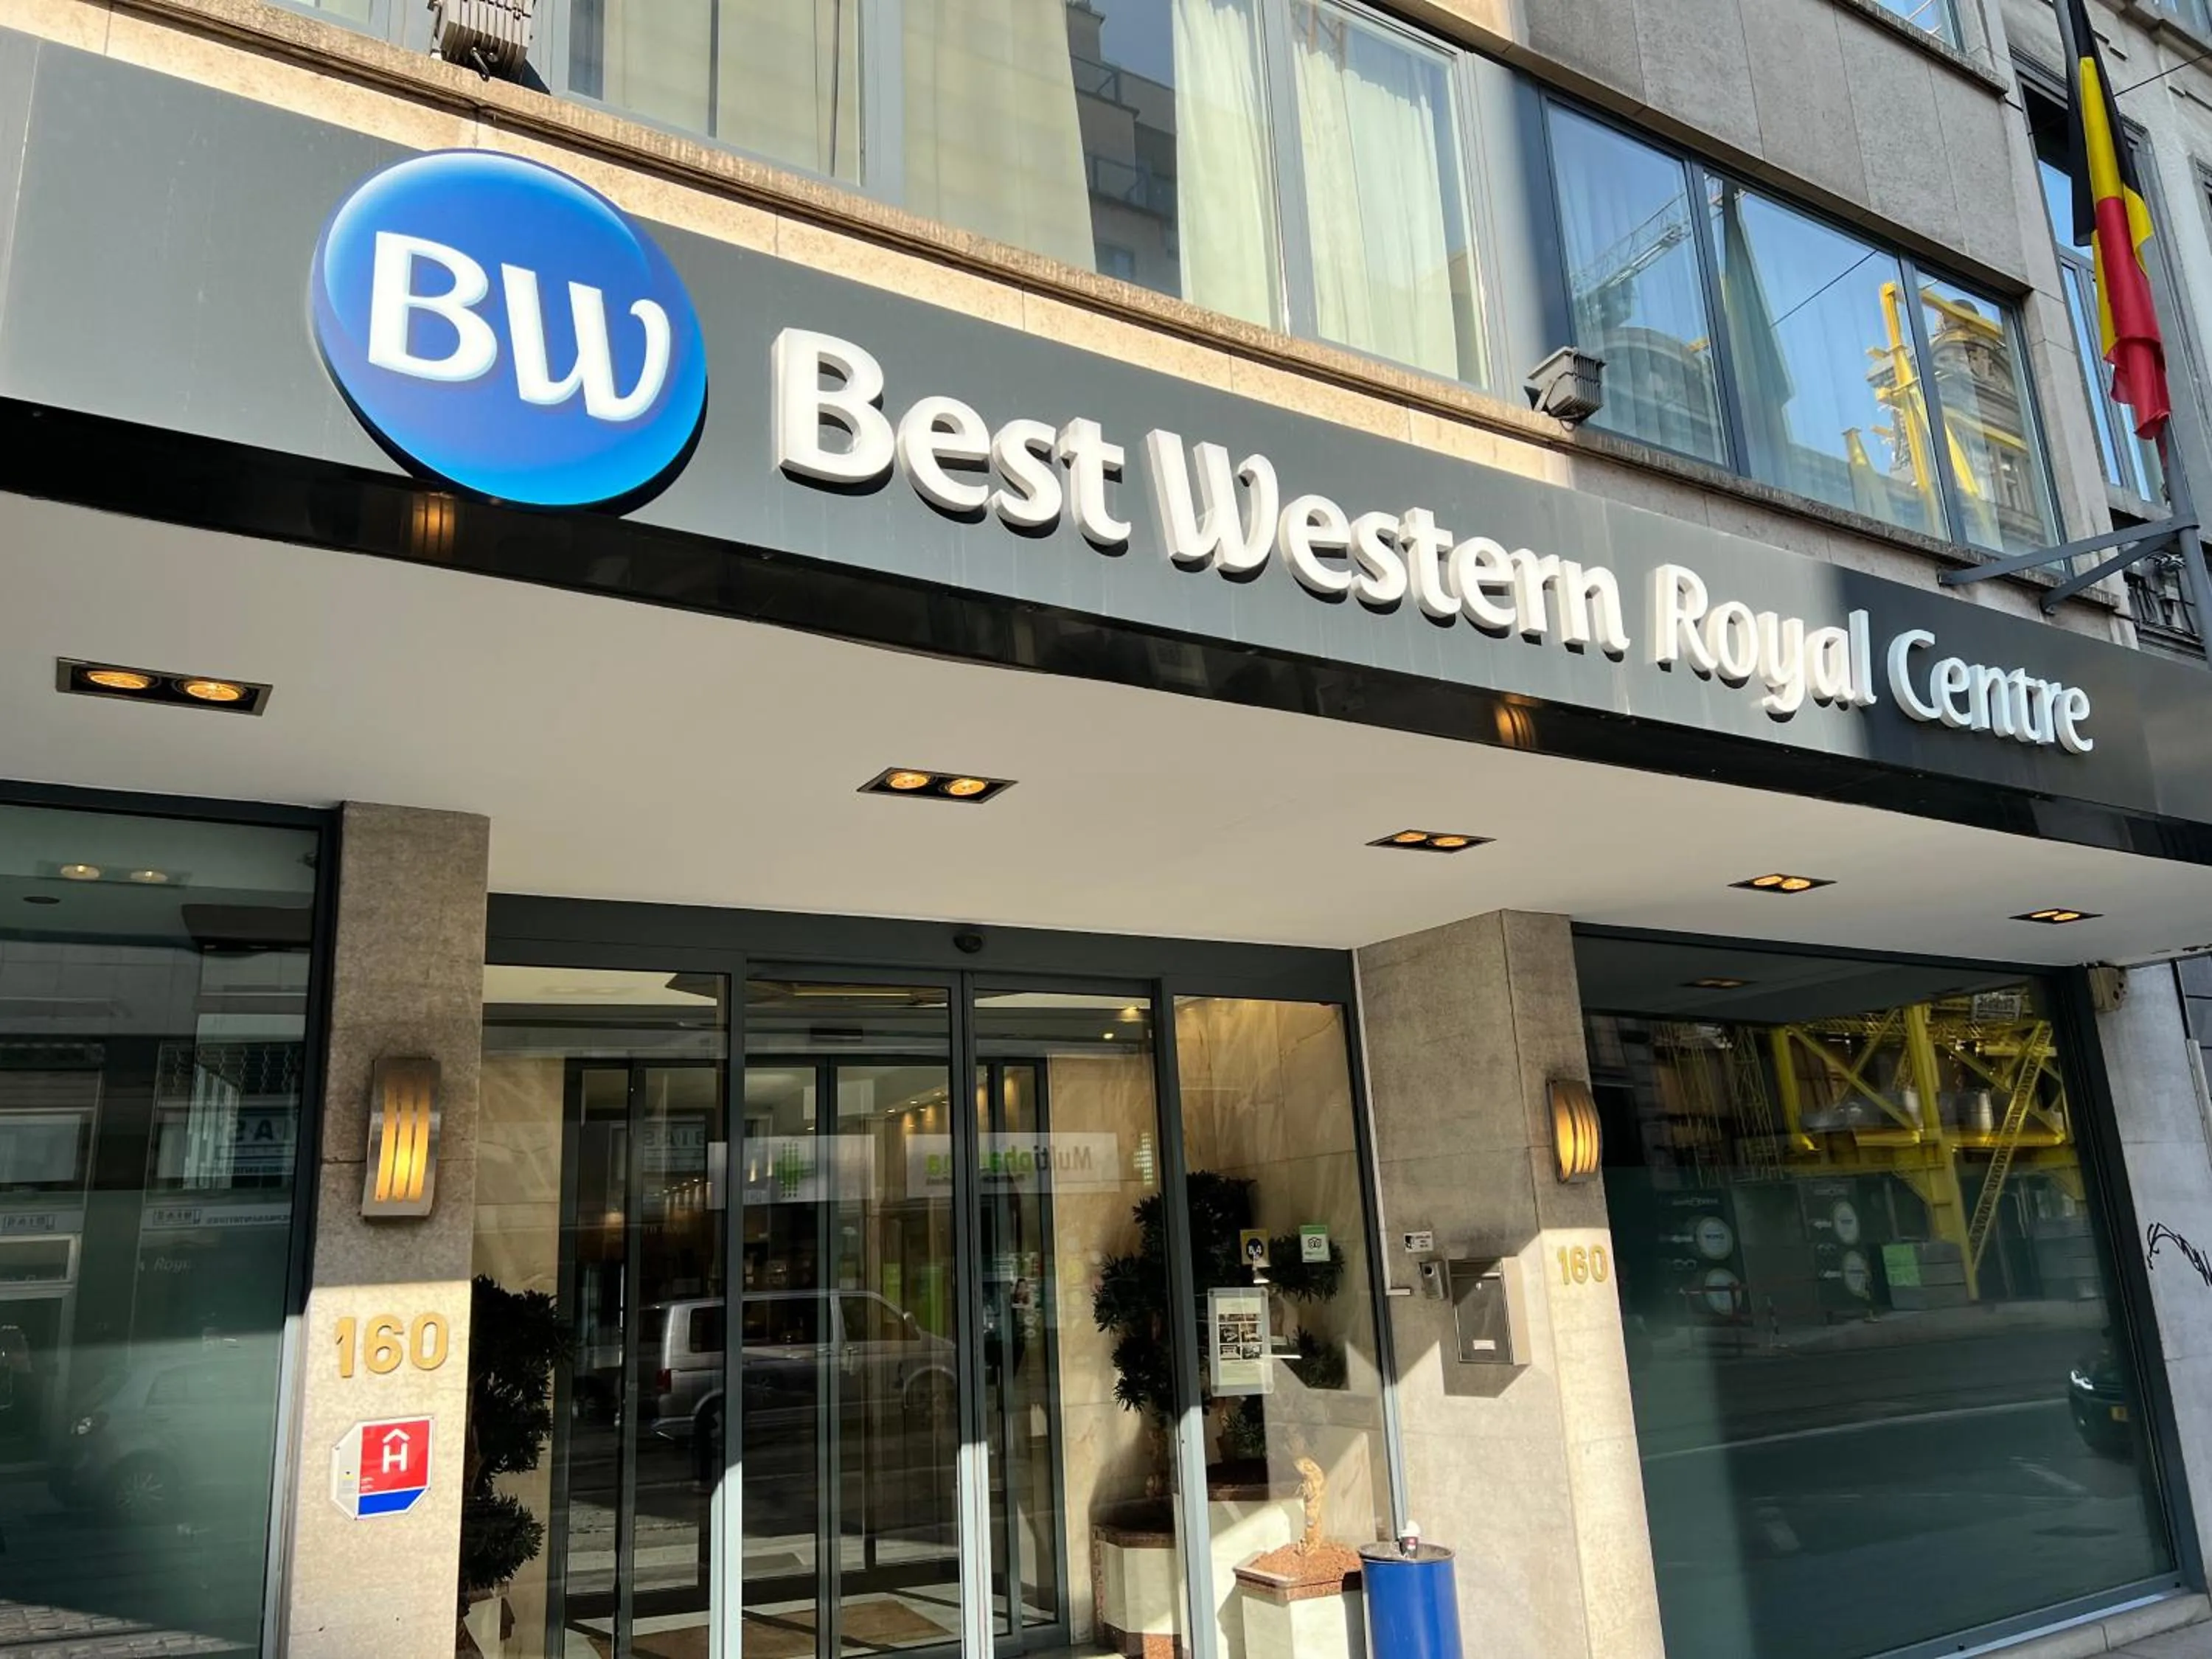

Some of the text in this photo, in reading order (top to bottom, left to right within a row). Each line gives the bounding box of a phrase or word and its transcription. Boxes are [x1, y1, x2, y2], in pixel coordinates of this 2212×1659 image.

[368, 231, 672, 422] BW
[771, 327, 2094, 754] Best Western Royal Centre
[1557, 1245, 1608, 1285] 160
[335, 1312, 449, 1378] 160
